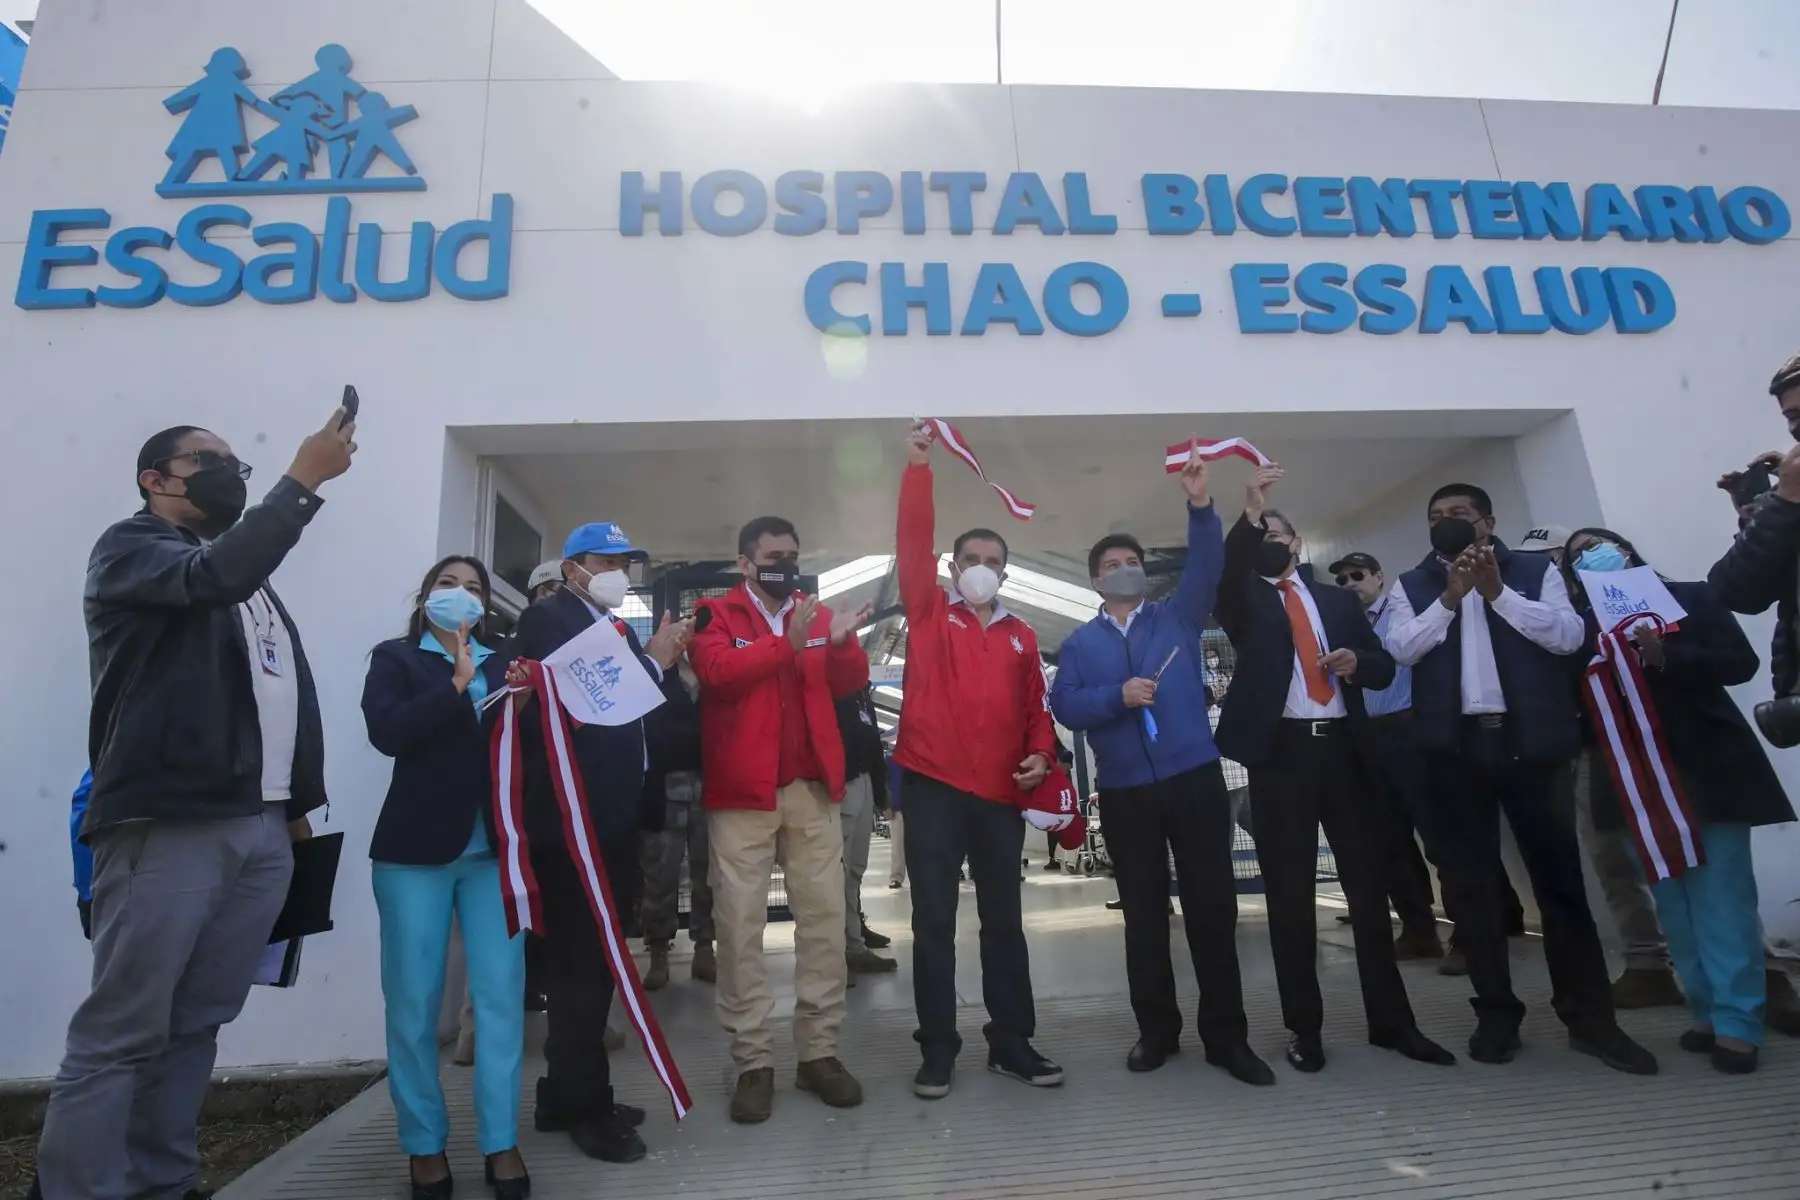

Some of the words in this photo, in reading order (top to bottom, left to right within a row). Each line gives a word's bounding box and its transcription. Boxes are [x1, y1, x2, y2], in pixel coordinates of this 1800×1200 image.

[619, 169, 1117, 237] HOSPITAL
[1141, 173, 1792, 244] BICENTENARIO
[15, 193, 514, 310] EsSalud
[804, 260, 1129, 337] CHAO
[1161, 293, 1202, 317] -
[1230, 262, 1677, 335] ESSALUD
[1603, 599, 1649, 616] EsSalud
[569, 657, 615, 711] EsSalud
